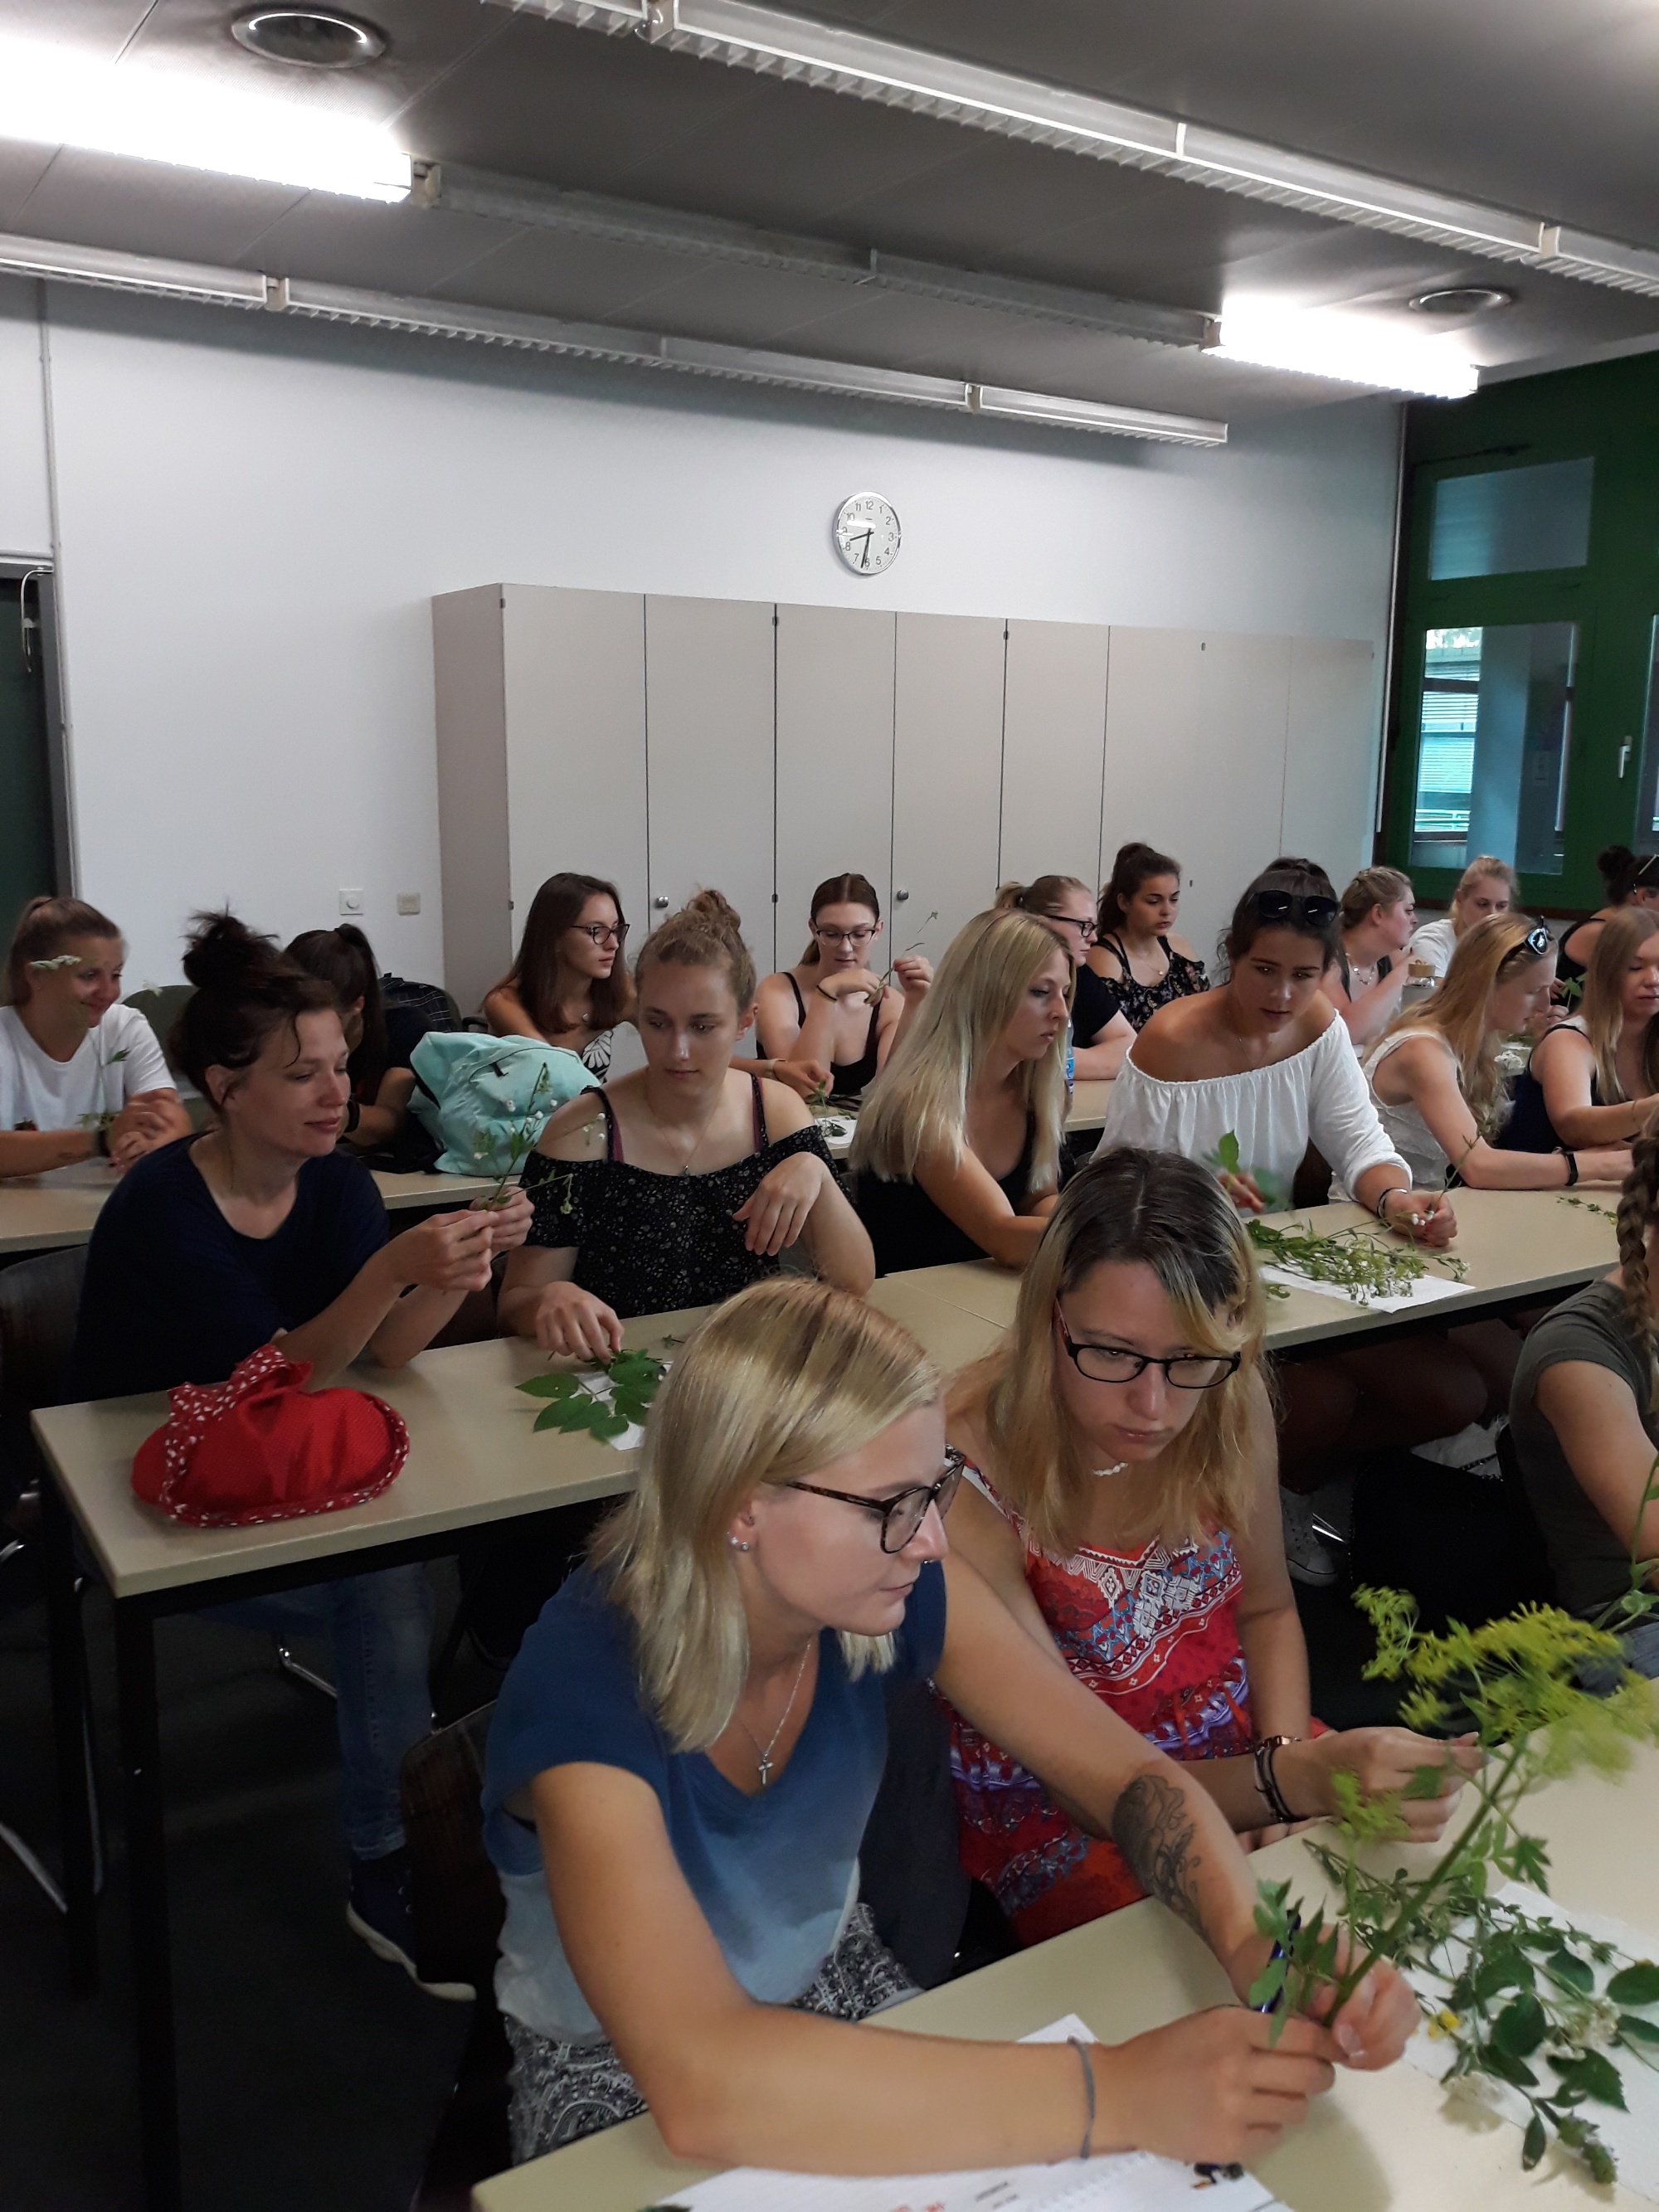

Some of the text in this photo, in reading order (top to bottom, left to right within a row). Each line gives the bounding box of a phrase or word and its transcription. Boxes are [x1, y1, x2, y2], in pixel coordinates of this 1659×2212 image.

[855, 502, 862, 512] 11
[865, 500, 874, 511] 12
[878, 506, 883, 514] 1
[846, 513, 855, 521] 10
[885, 516, 892, 525] 2
[888, 532, 894, 542] 3
[845, 542, 851, 552] 8
[884, 547, 890, 556] 4
[854, 552, 859, 562] 7
[864, 557, 870, 567] 6
[876, 556, 882, 566] 5
